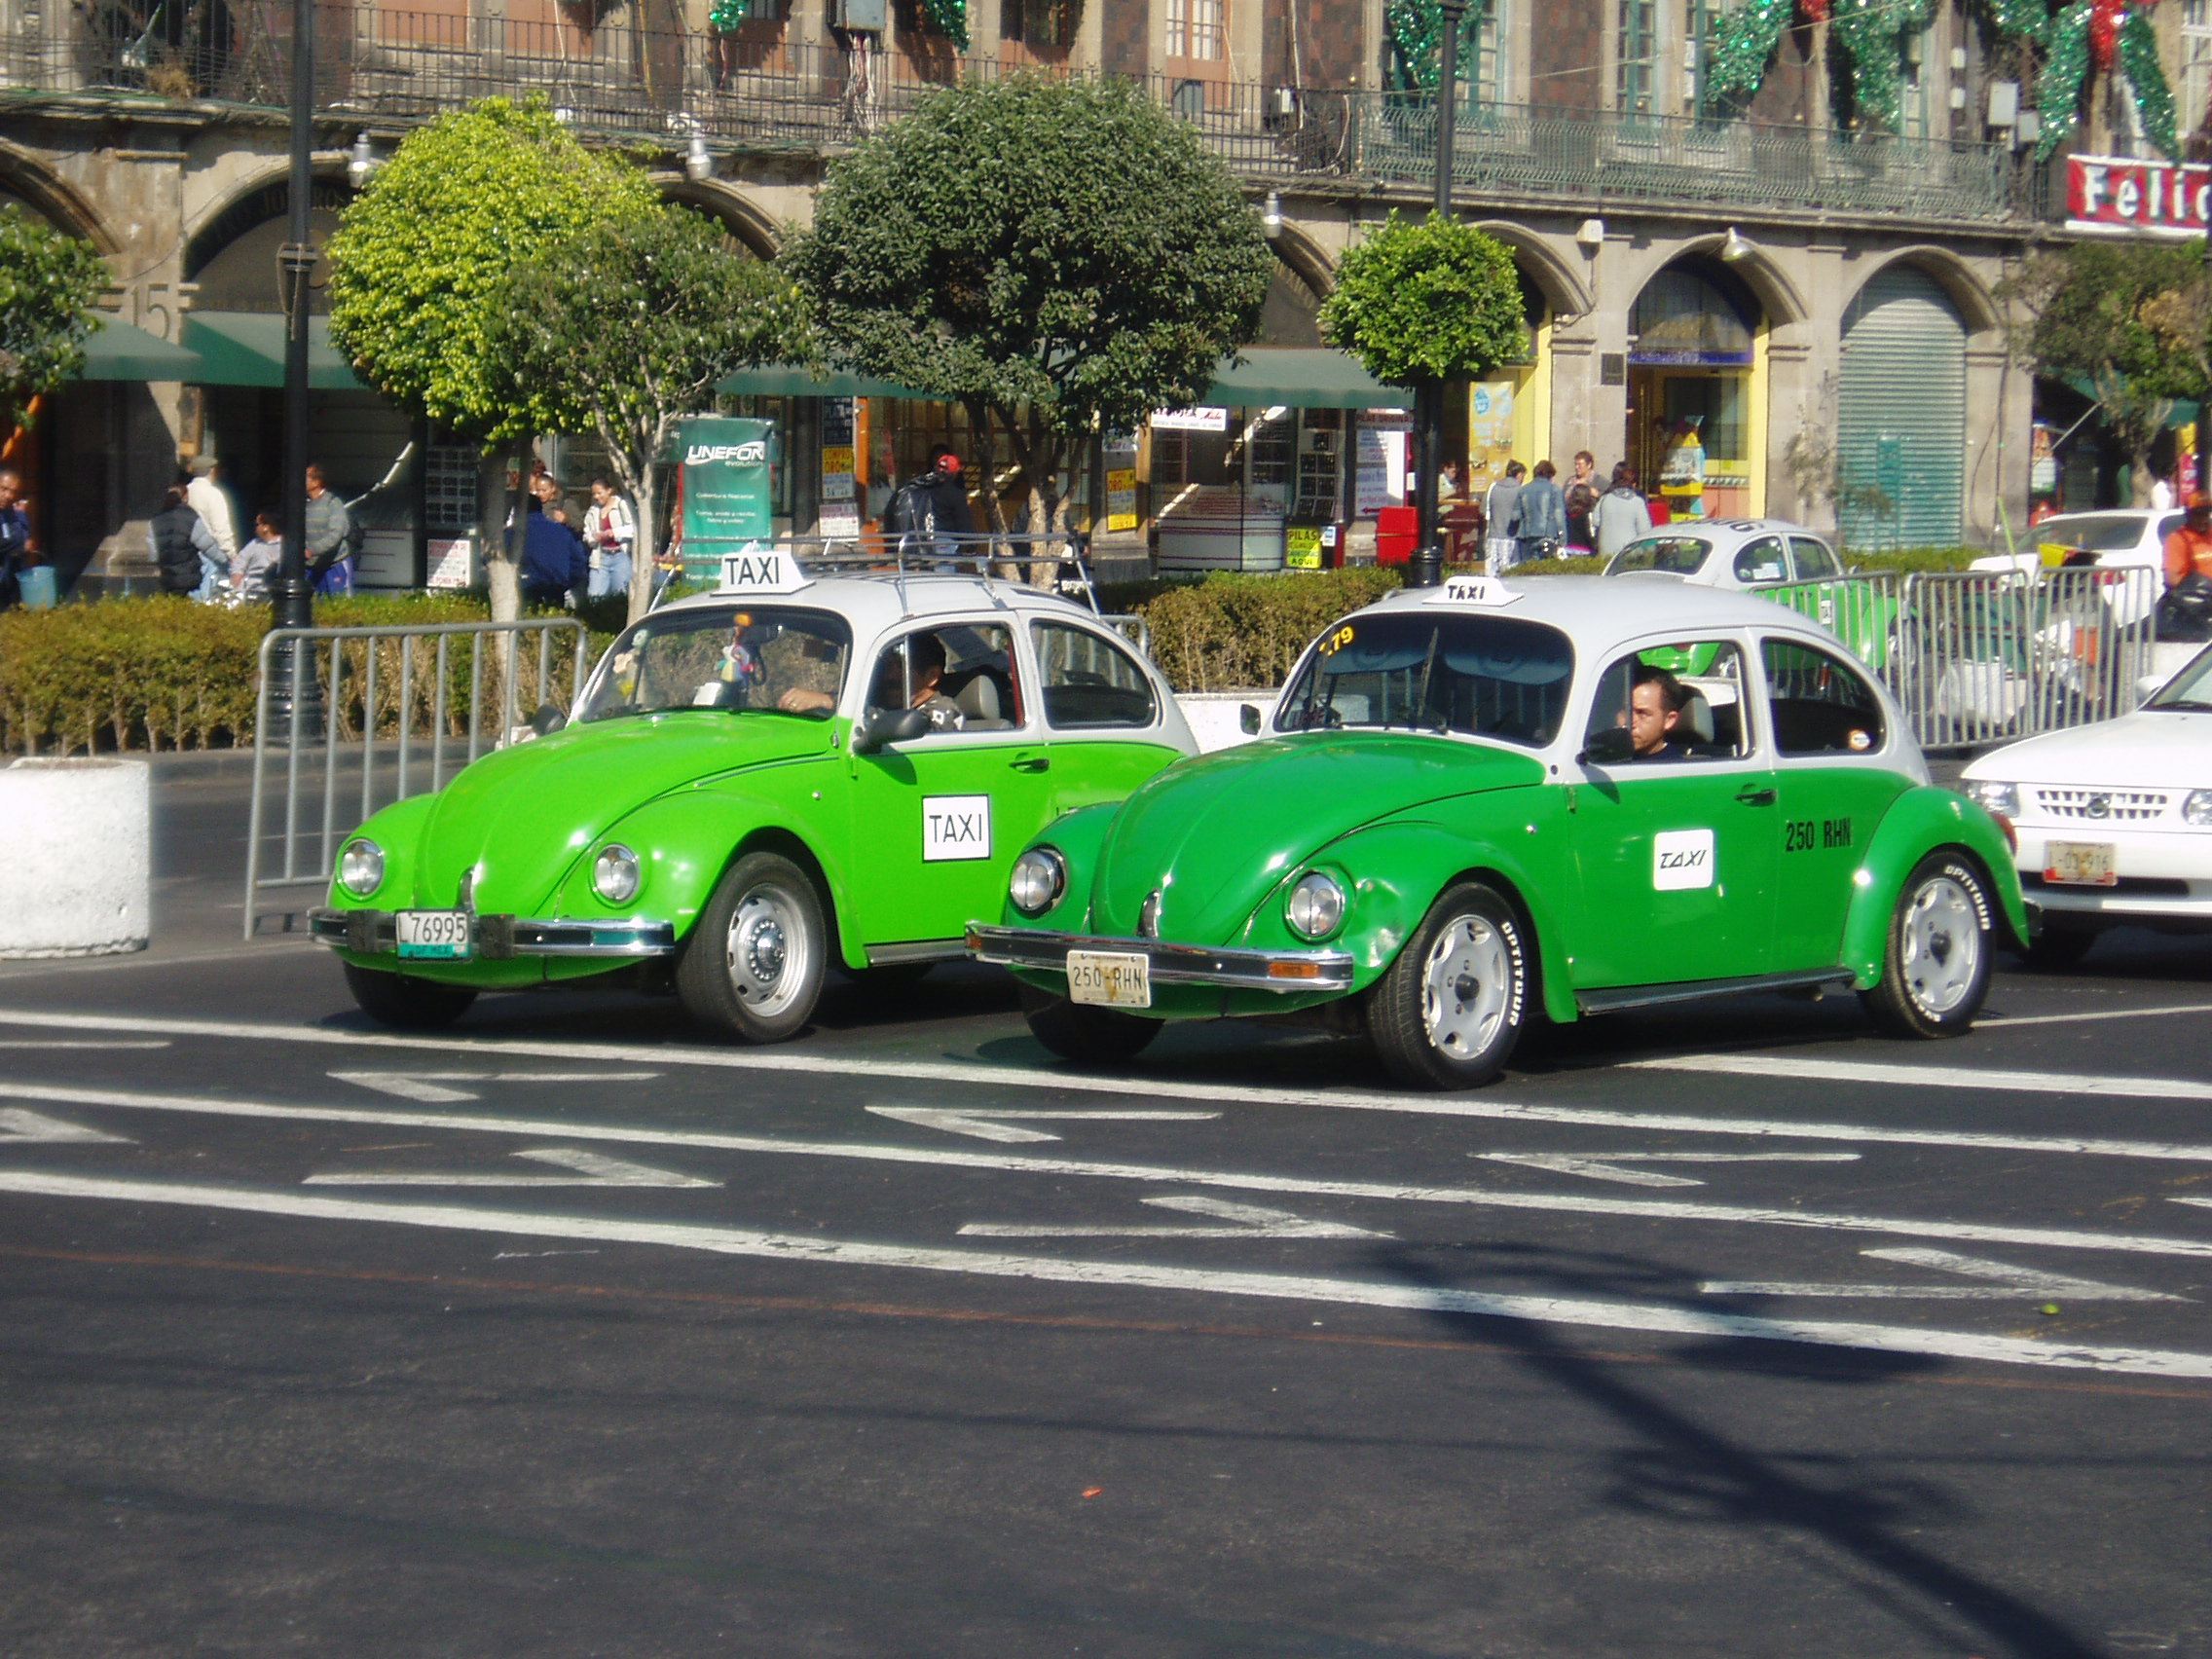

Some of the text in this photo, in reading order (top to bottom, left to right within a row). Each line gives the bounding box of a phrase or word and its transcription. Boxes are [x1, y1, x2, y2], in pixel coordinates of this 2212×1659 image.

[131, 283, 170, 340] 15
[685, 442, 765, 462] UNEFON
[1288, 531, 1317, 540] PILAS
[724, 556, 780, 585] TAXI
[1448, 585, 1485, 600] TAXI
[928, 813, 982, 843] TAXI
[1786, 817, 1853, 853] 250 RHN
[1660, 849, 1708, 869] TAXI
